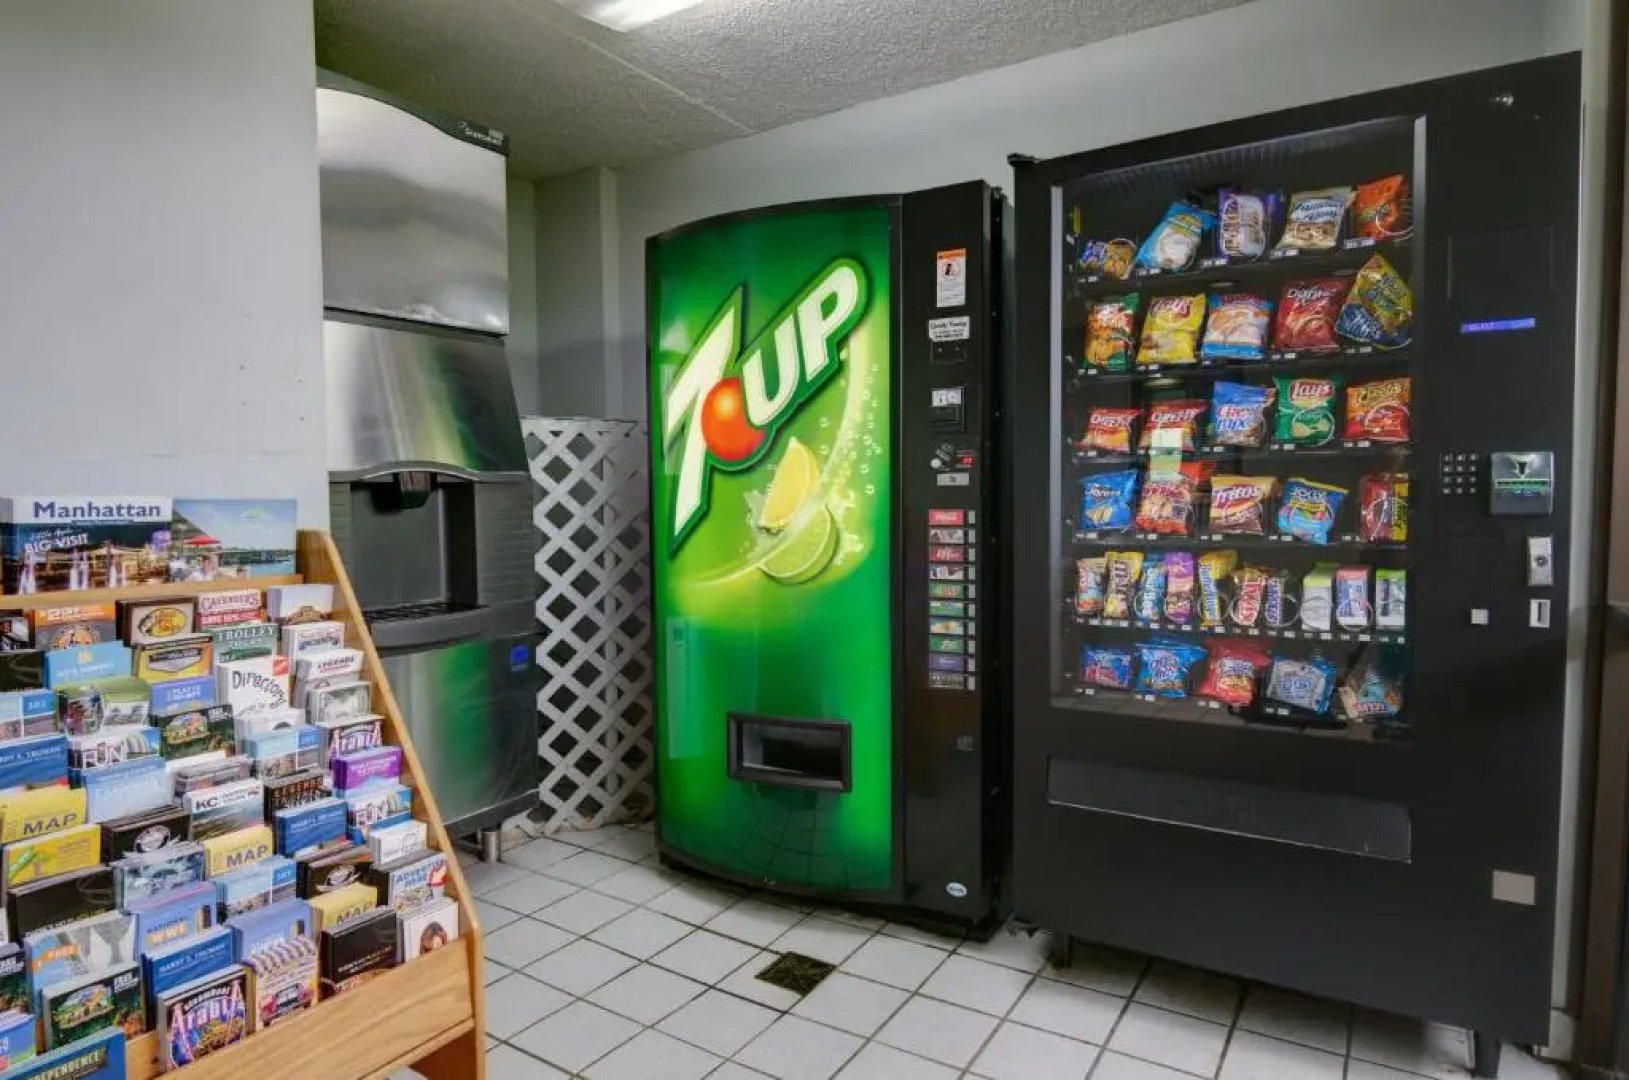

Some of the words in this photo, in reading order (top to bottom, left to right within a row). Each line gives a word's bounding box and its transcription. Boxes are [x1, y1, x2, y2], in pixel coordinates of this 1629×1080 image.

[667, 263, 858, 537] 7UP
[34, 501, 161, 519] Manhattan
[216, 626, 275, 642] TROLLEY
[195, 796, 219, 811] KC
[23, 812, 78, 835] MAP
[226, 844, 268, 868] MAP
